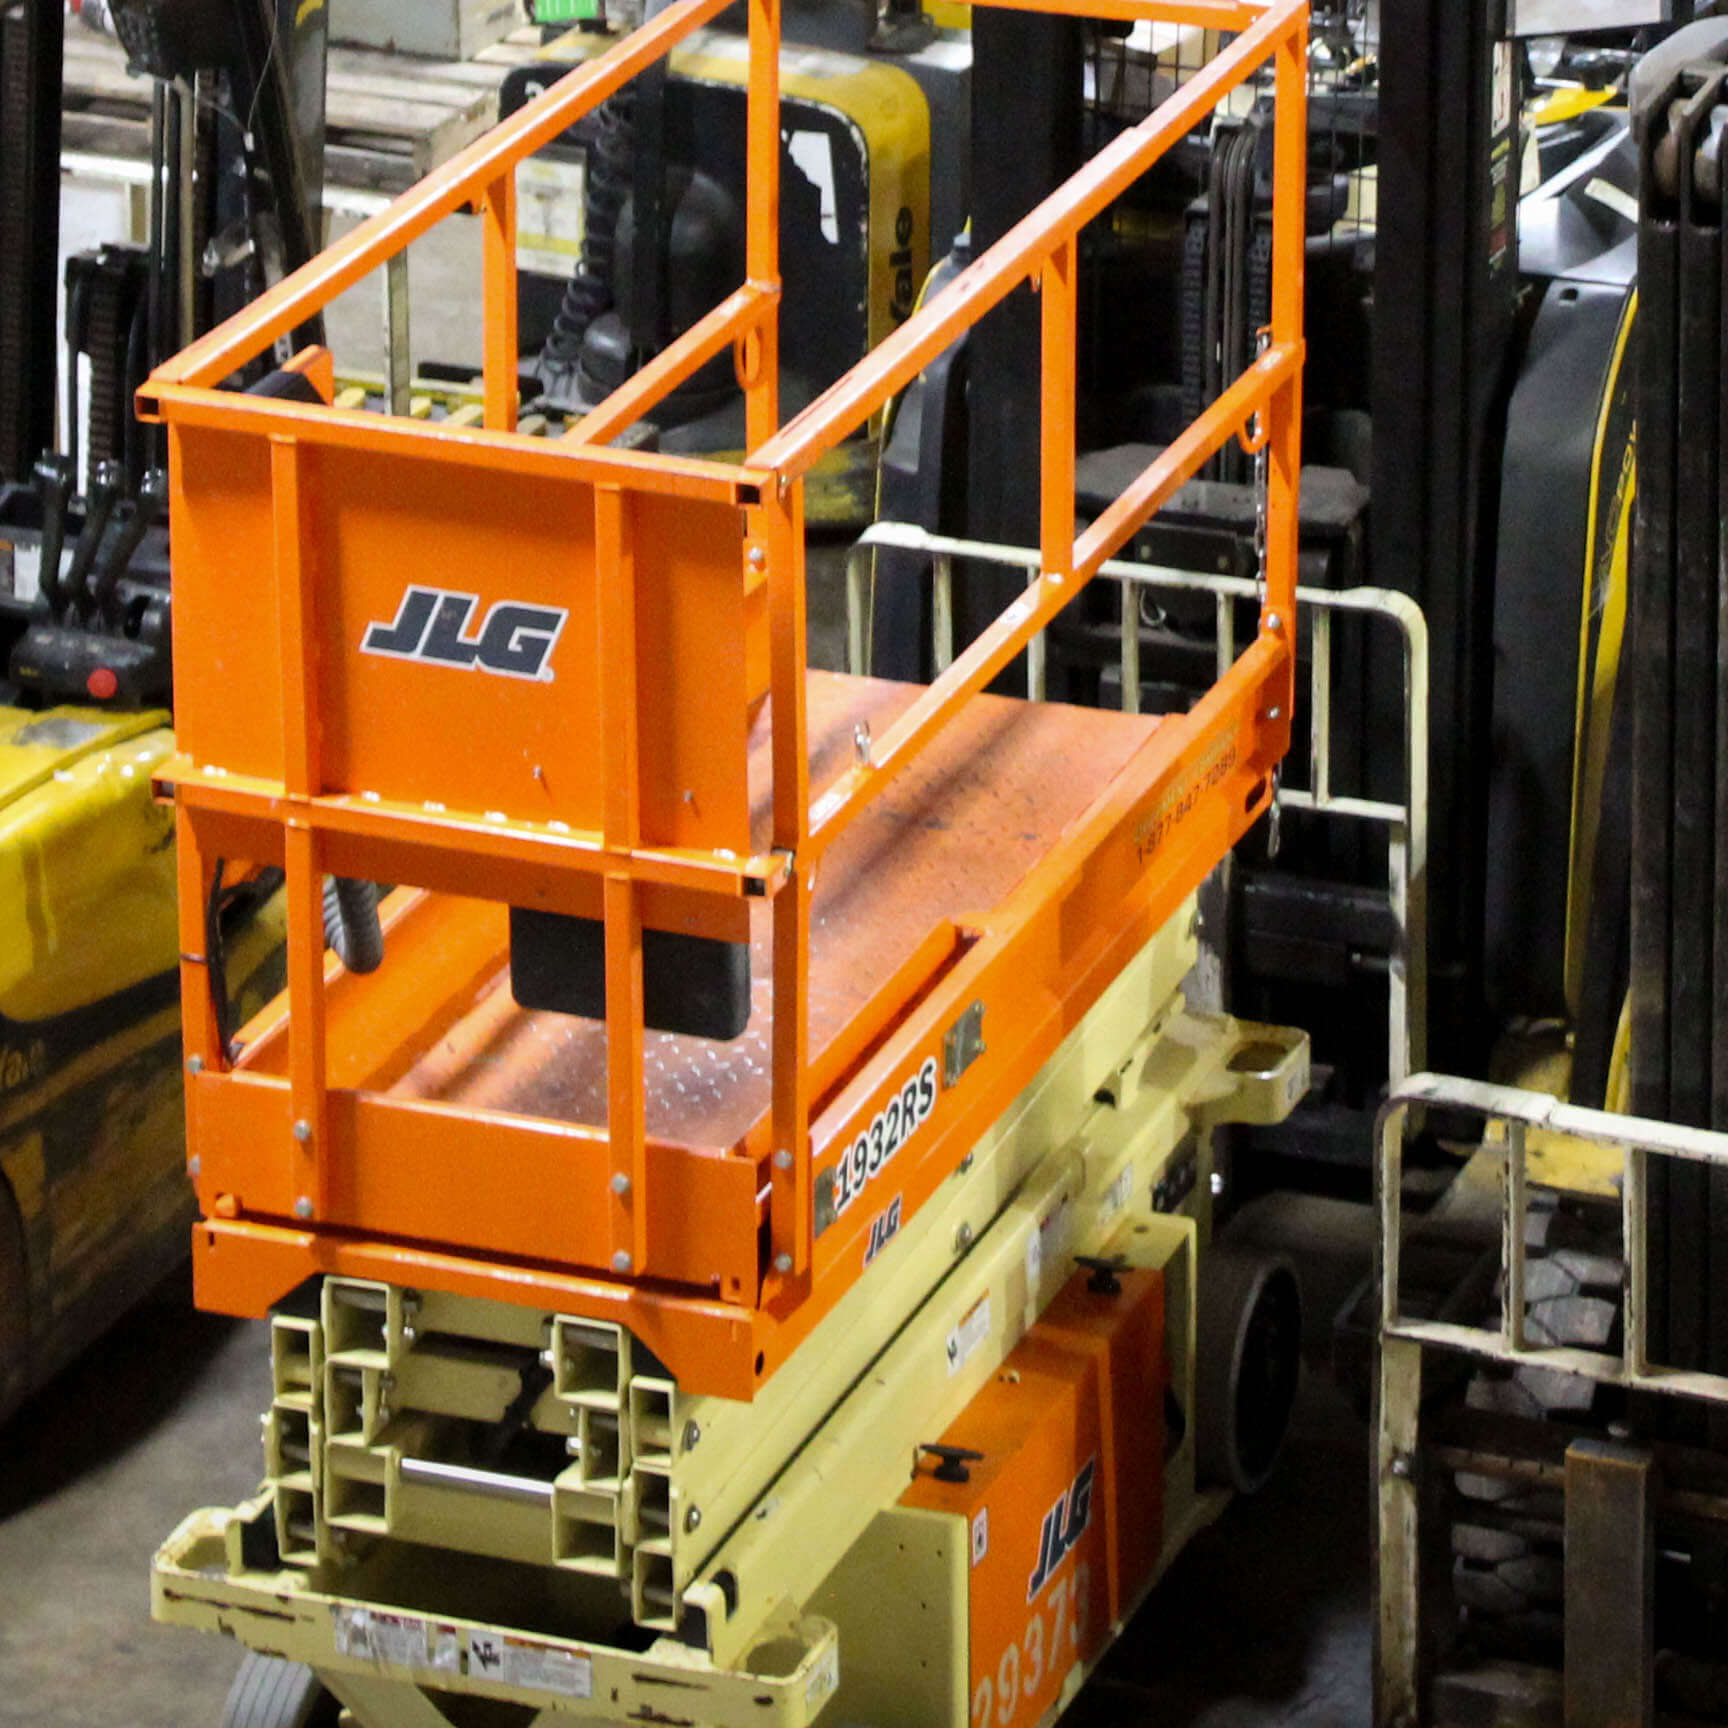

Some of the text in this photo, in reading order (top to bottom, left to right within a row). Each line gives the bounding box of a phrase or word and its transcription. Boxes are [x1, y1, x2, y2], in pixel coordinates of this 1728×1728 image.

[359, 583, 570, 683] JLG
[835, 1057, 936, 1215] 1932RS
[863, 1192, 903, 1267] JLG
[1027, 1452, 1097, 1605] JLG
